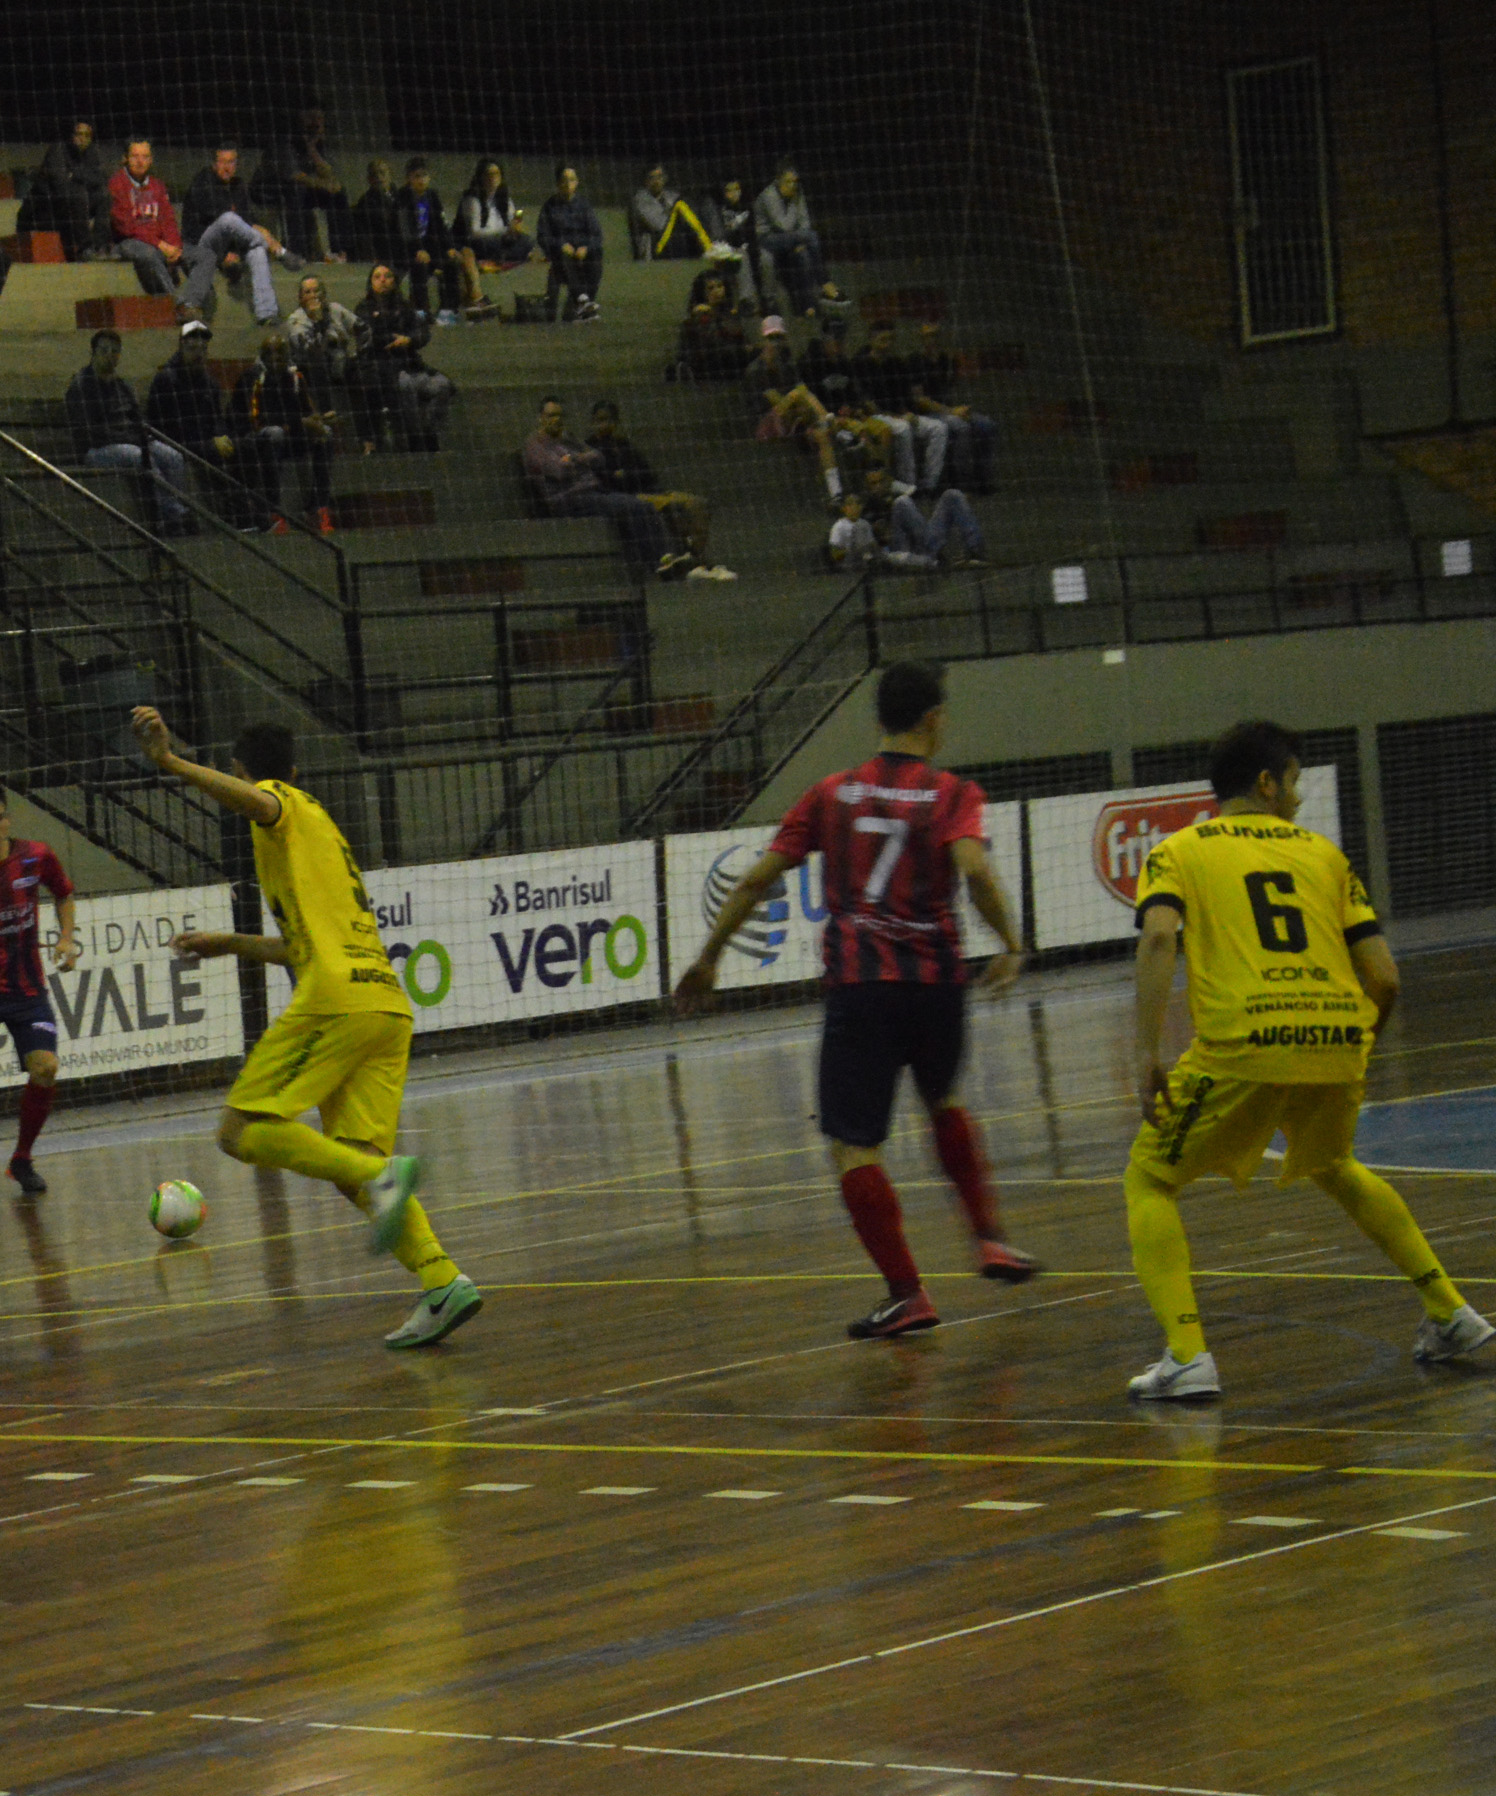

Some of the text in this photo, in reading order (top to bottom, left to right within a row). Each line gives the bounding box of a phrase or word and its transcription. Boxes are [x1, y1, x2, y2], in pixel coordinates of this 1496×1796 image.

[514, 868, 612, 913] Banrisul
[852, 815, 911, 904] 7
[1244, 871, 1309, 953] 6
[489, 914, 648, 994] vero
[1248, 1025, 1344, 1047] AUGUSTA
